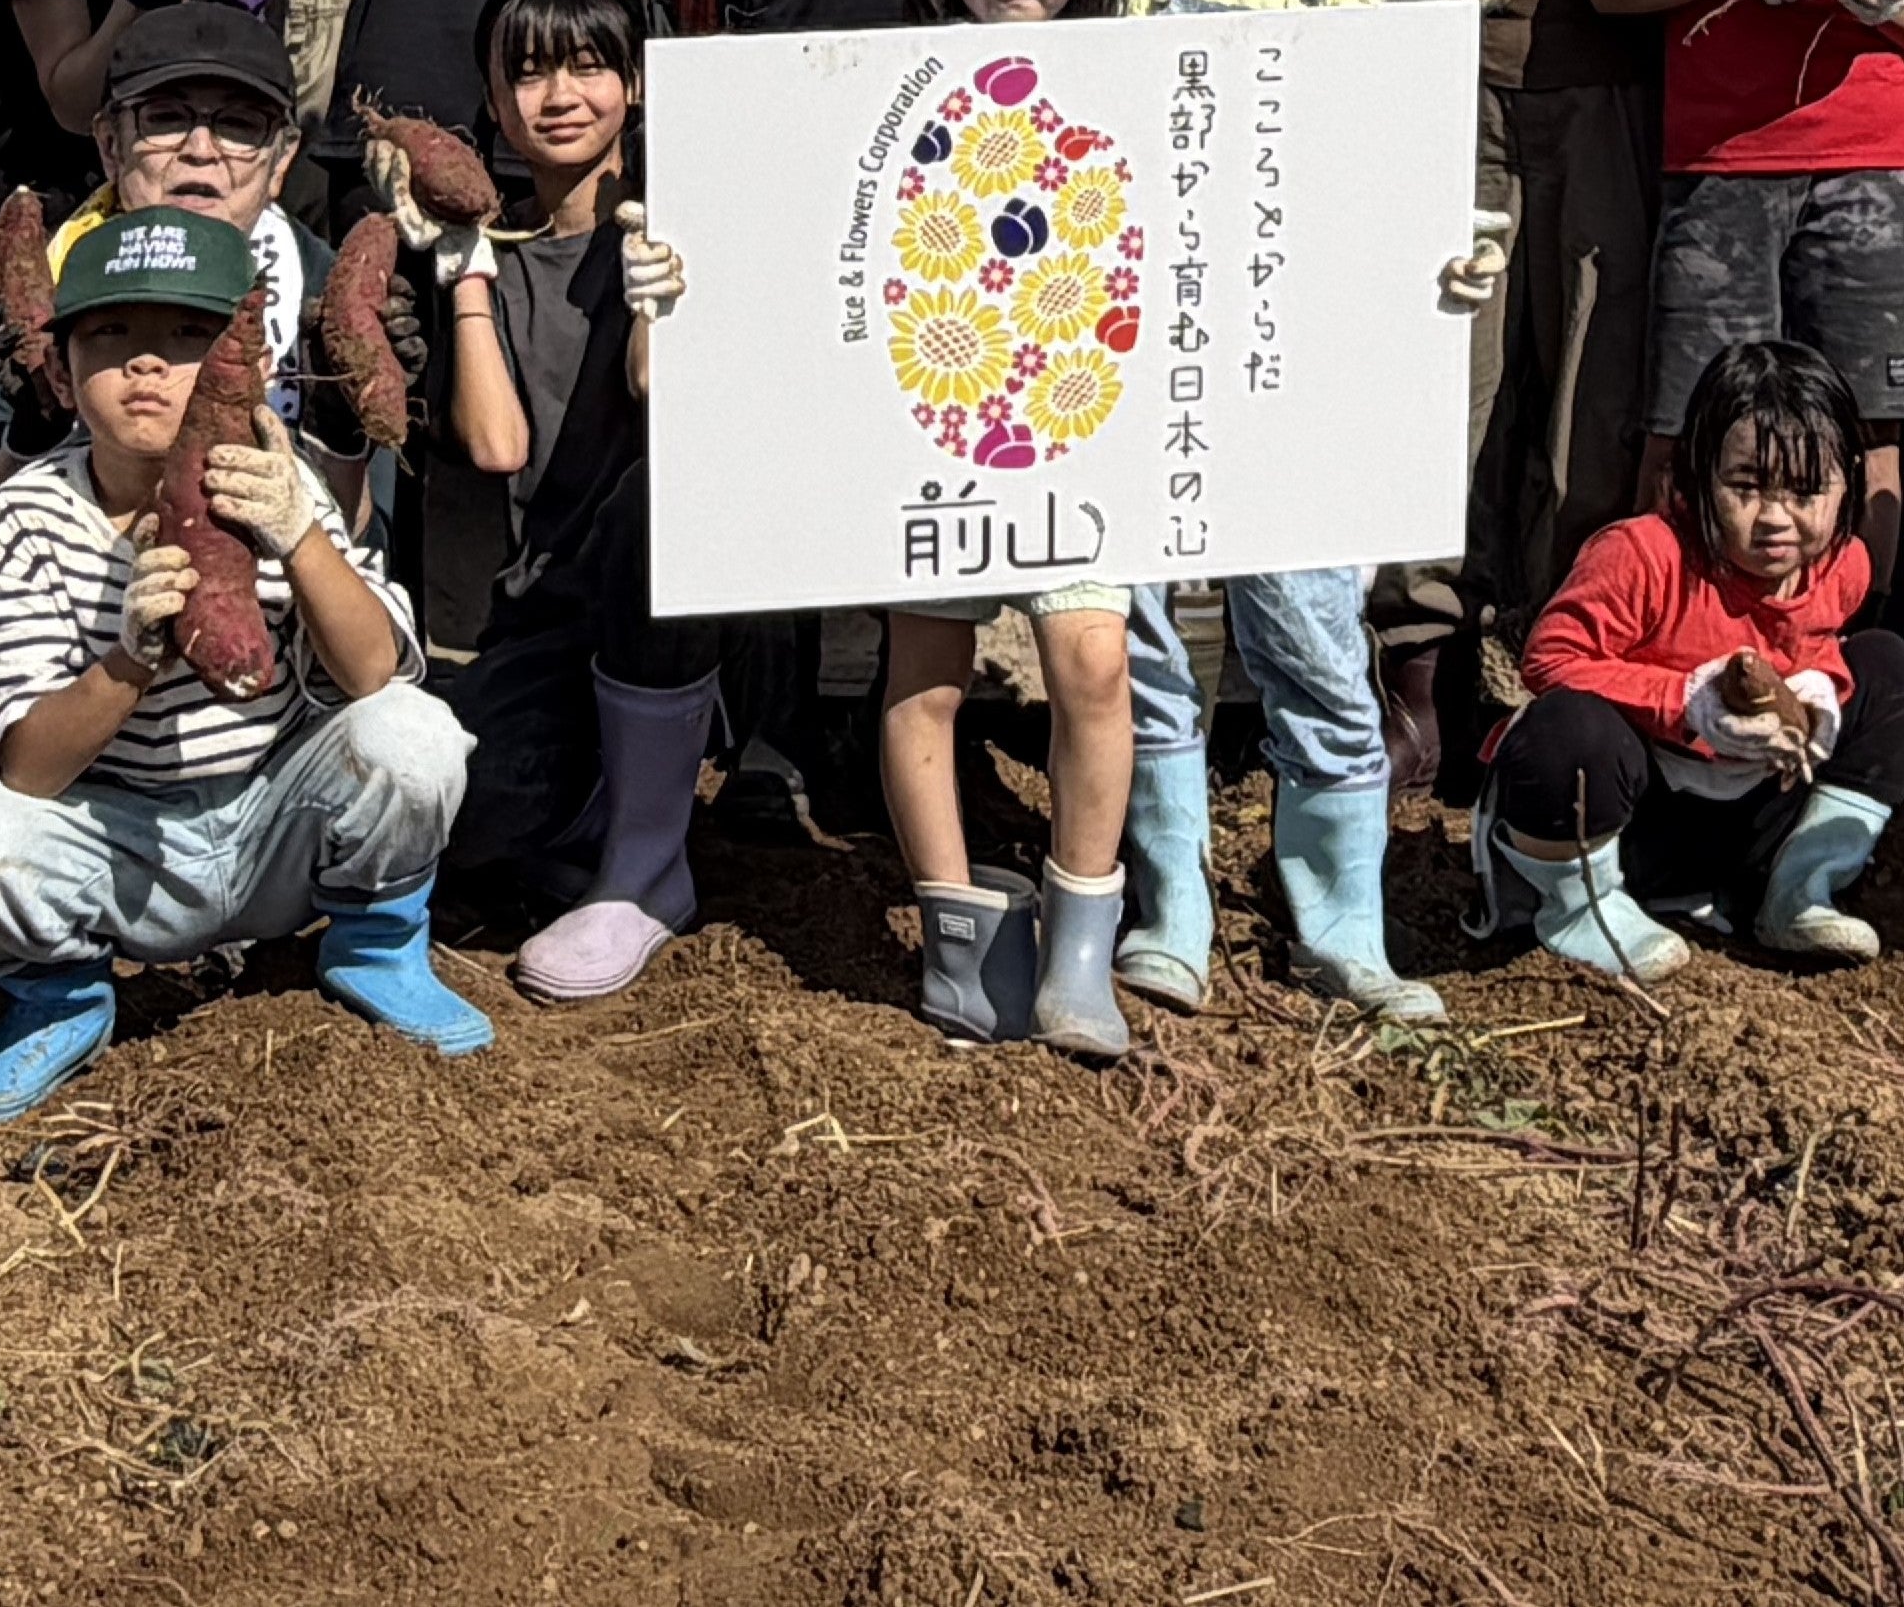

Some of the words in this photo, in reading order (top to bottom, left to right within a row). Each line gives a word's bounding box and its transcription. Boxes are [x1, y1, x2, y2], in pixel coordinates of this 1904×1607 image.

[859, 55, 944, 174] Corporation
[840, 178, 878, 262] Flowers
[1243, 47, 1285, 393] こころとからだ
[838, 269, 864, 288] &
[842, 295, 869, 344] Rice
[1164, 49, 1216, 557] 黒部から育む日本の心
[900, 479, 1105, 578] 前山
